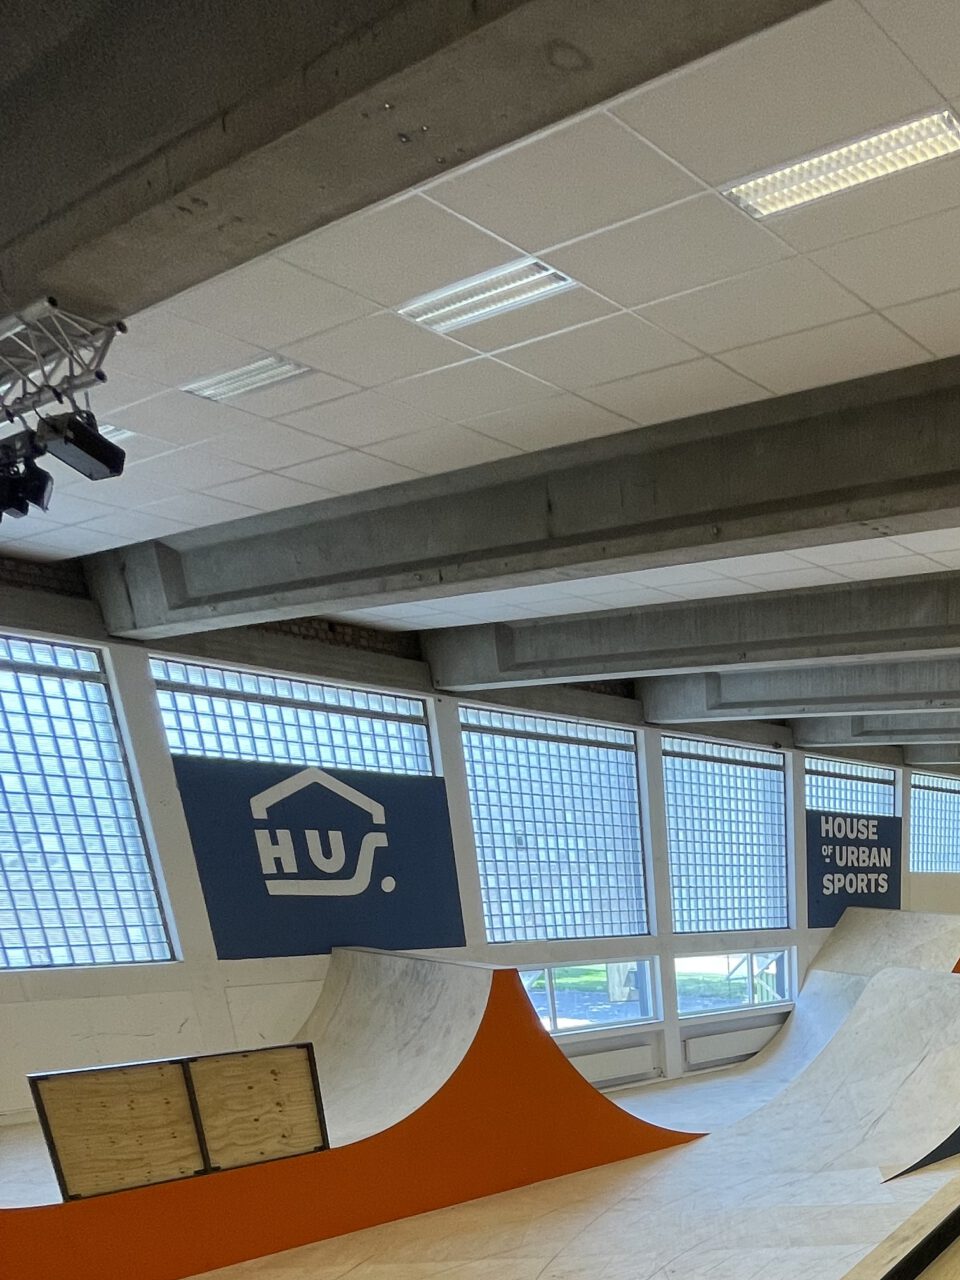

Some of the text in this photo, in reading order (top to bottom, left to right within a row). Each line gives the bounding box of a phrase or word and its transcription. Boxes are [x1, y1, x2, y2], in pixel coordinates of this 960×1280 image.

[821, 815, 878, 840] HOUSE
[821, 845, 891, 867] OF URBAN
[822, 873, 889, 896] SPORTS
